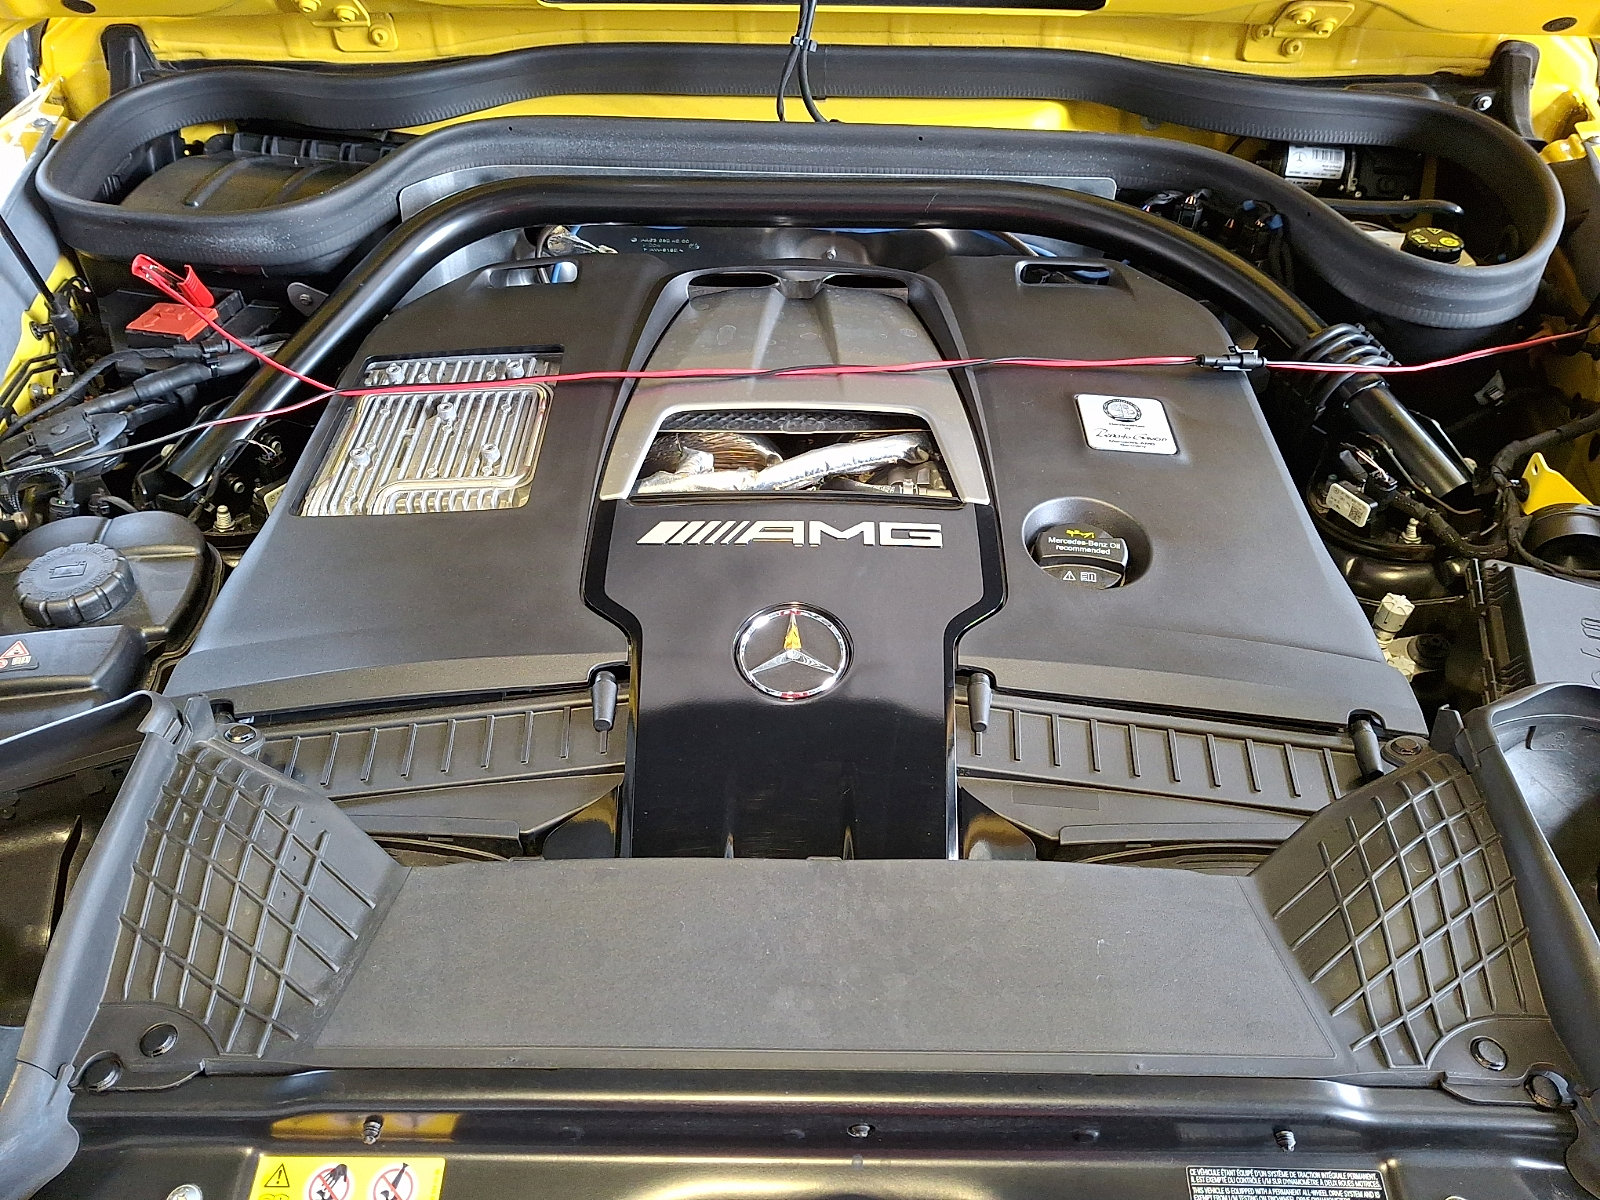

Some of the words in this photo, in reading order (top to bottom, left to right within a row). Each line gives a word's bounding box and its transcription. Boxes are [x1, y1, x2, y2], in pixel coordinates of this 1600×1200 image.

[734, 520, 943, 548] AMG
[1048, 536, 1108, 547] Mercedes-Benz
[1056, 545, 1110, 554] recommended
